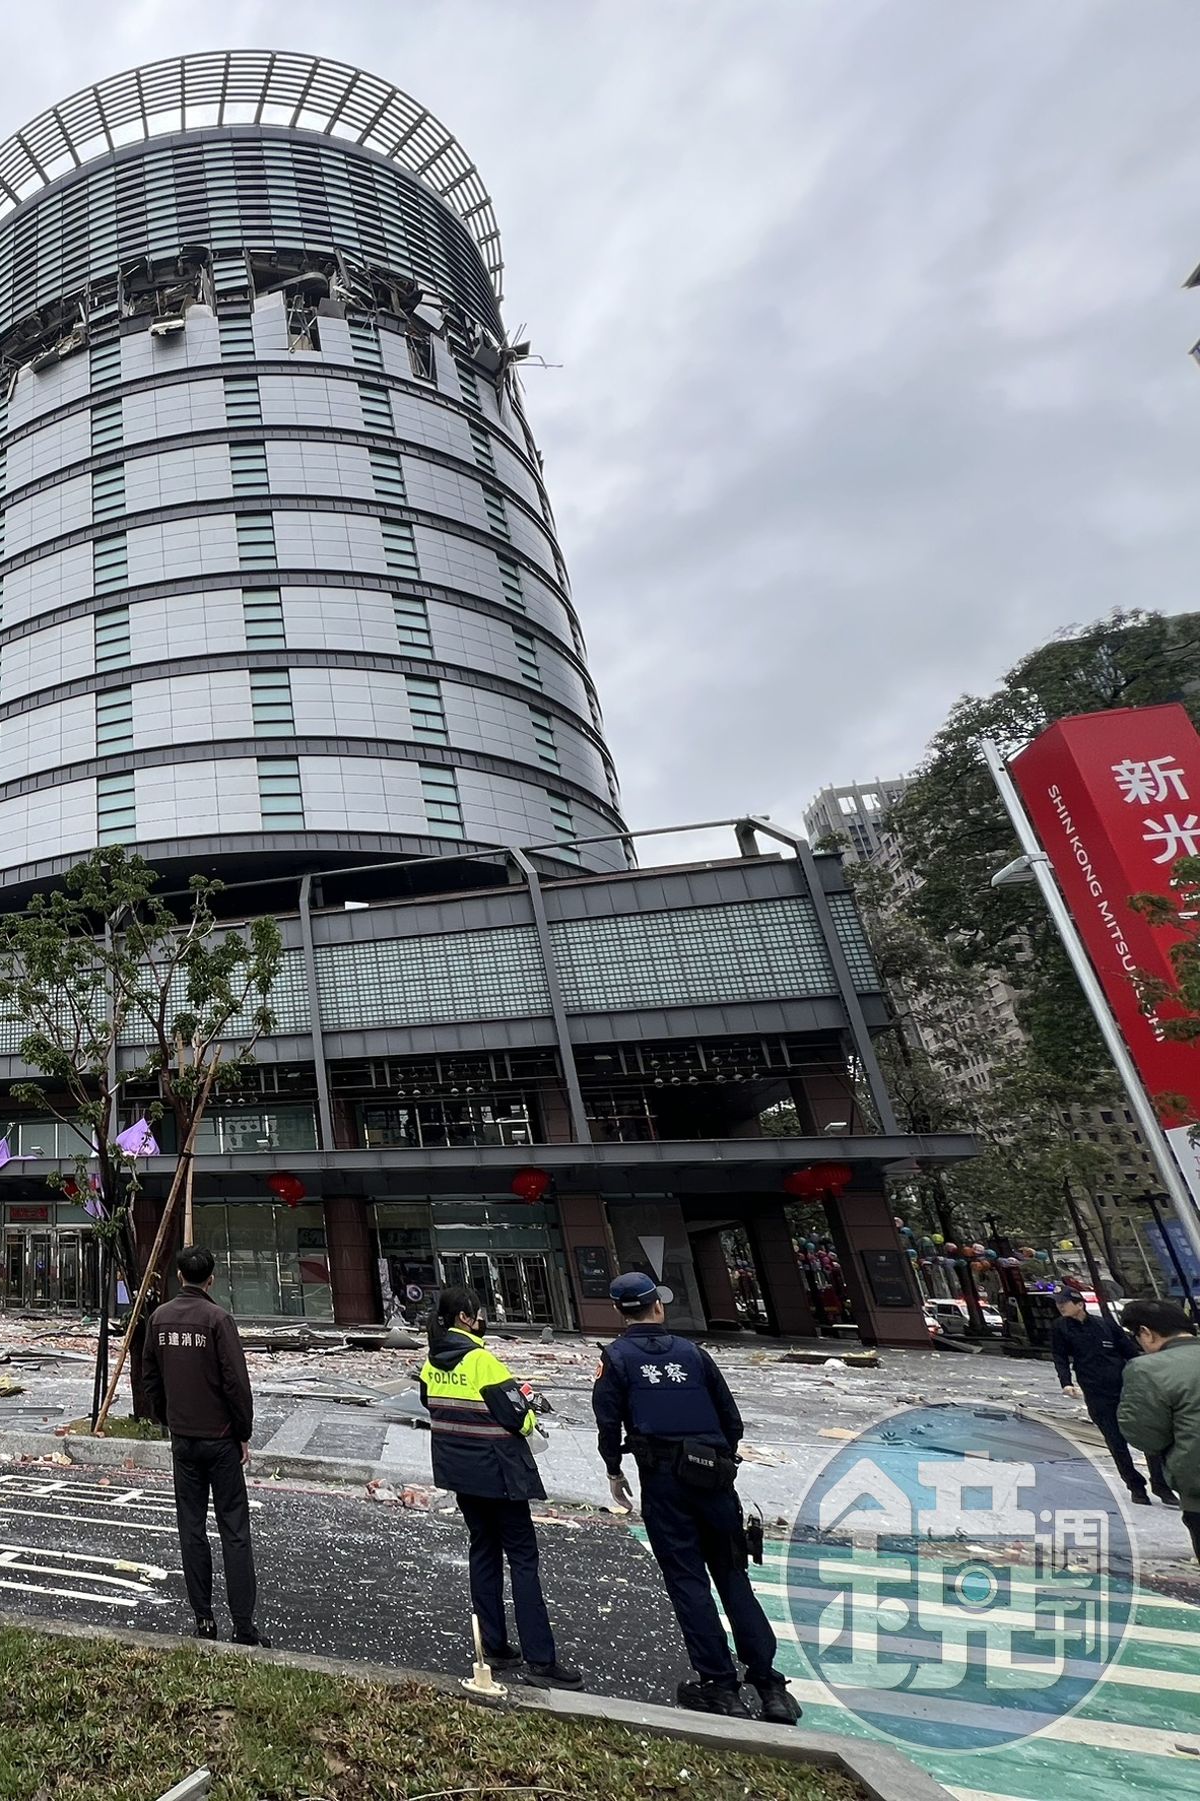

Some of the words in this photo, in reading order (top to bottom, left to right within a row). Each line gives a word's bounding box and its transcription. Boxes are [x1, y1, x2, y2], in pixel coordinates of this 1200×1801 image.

[1048, 784, 1075, 835] SHIN
[1069, 836, 1102, 897] KONG
[640, 1362, 688, 1384] 警察
